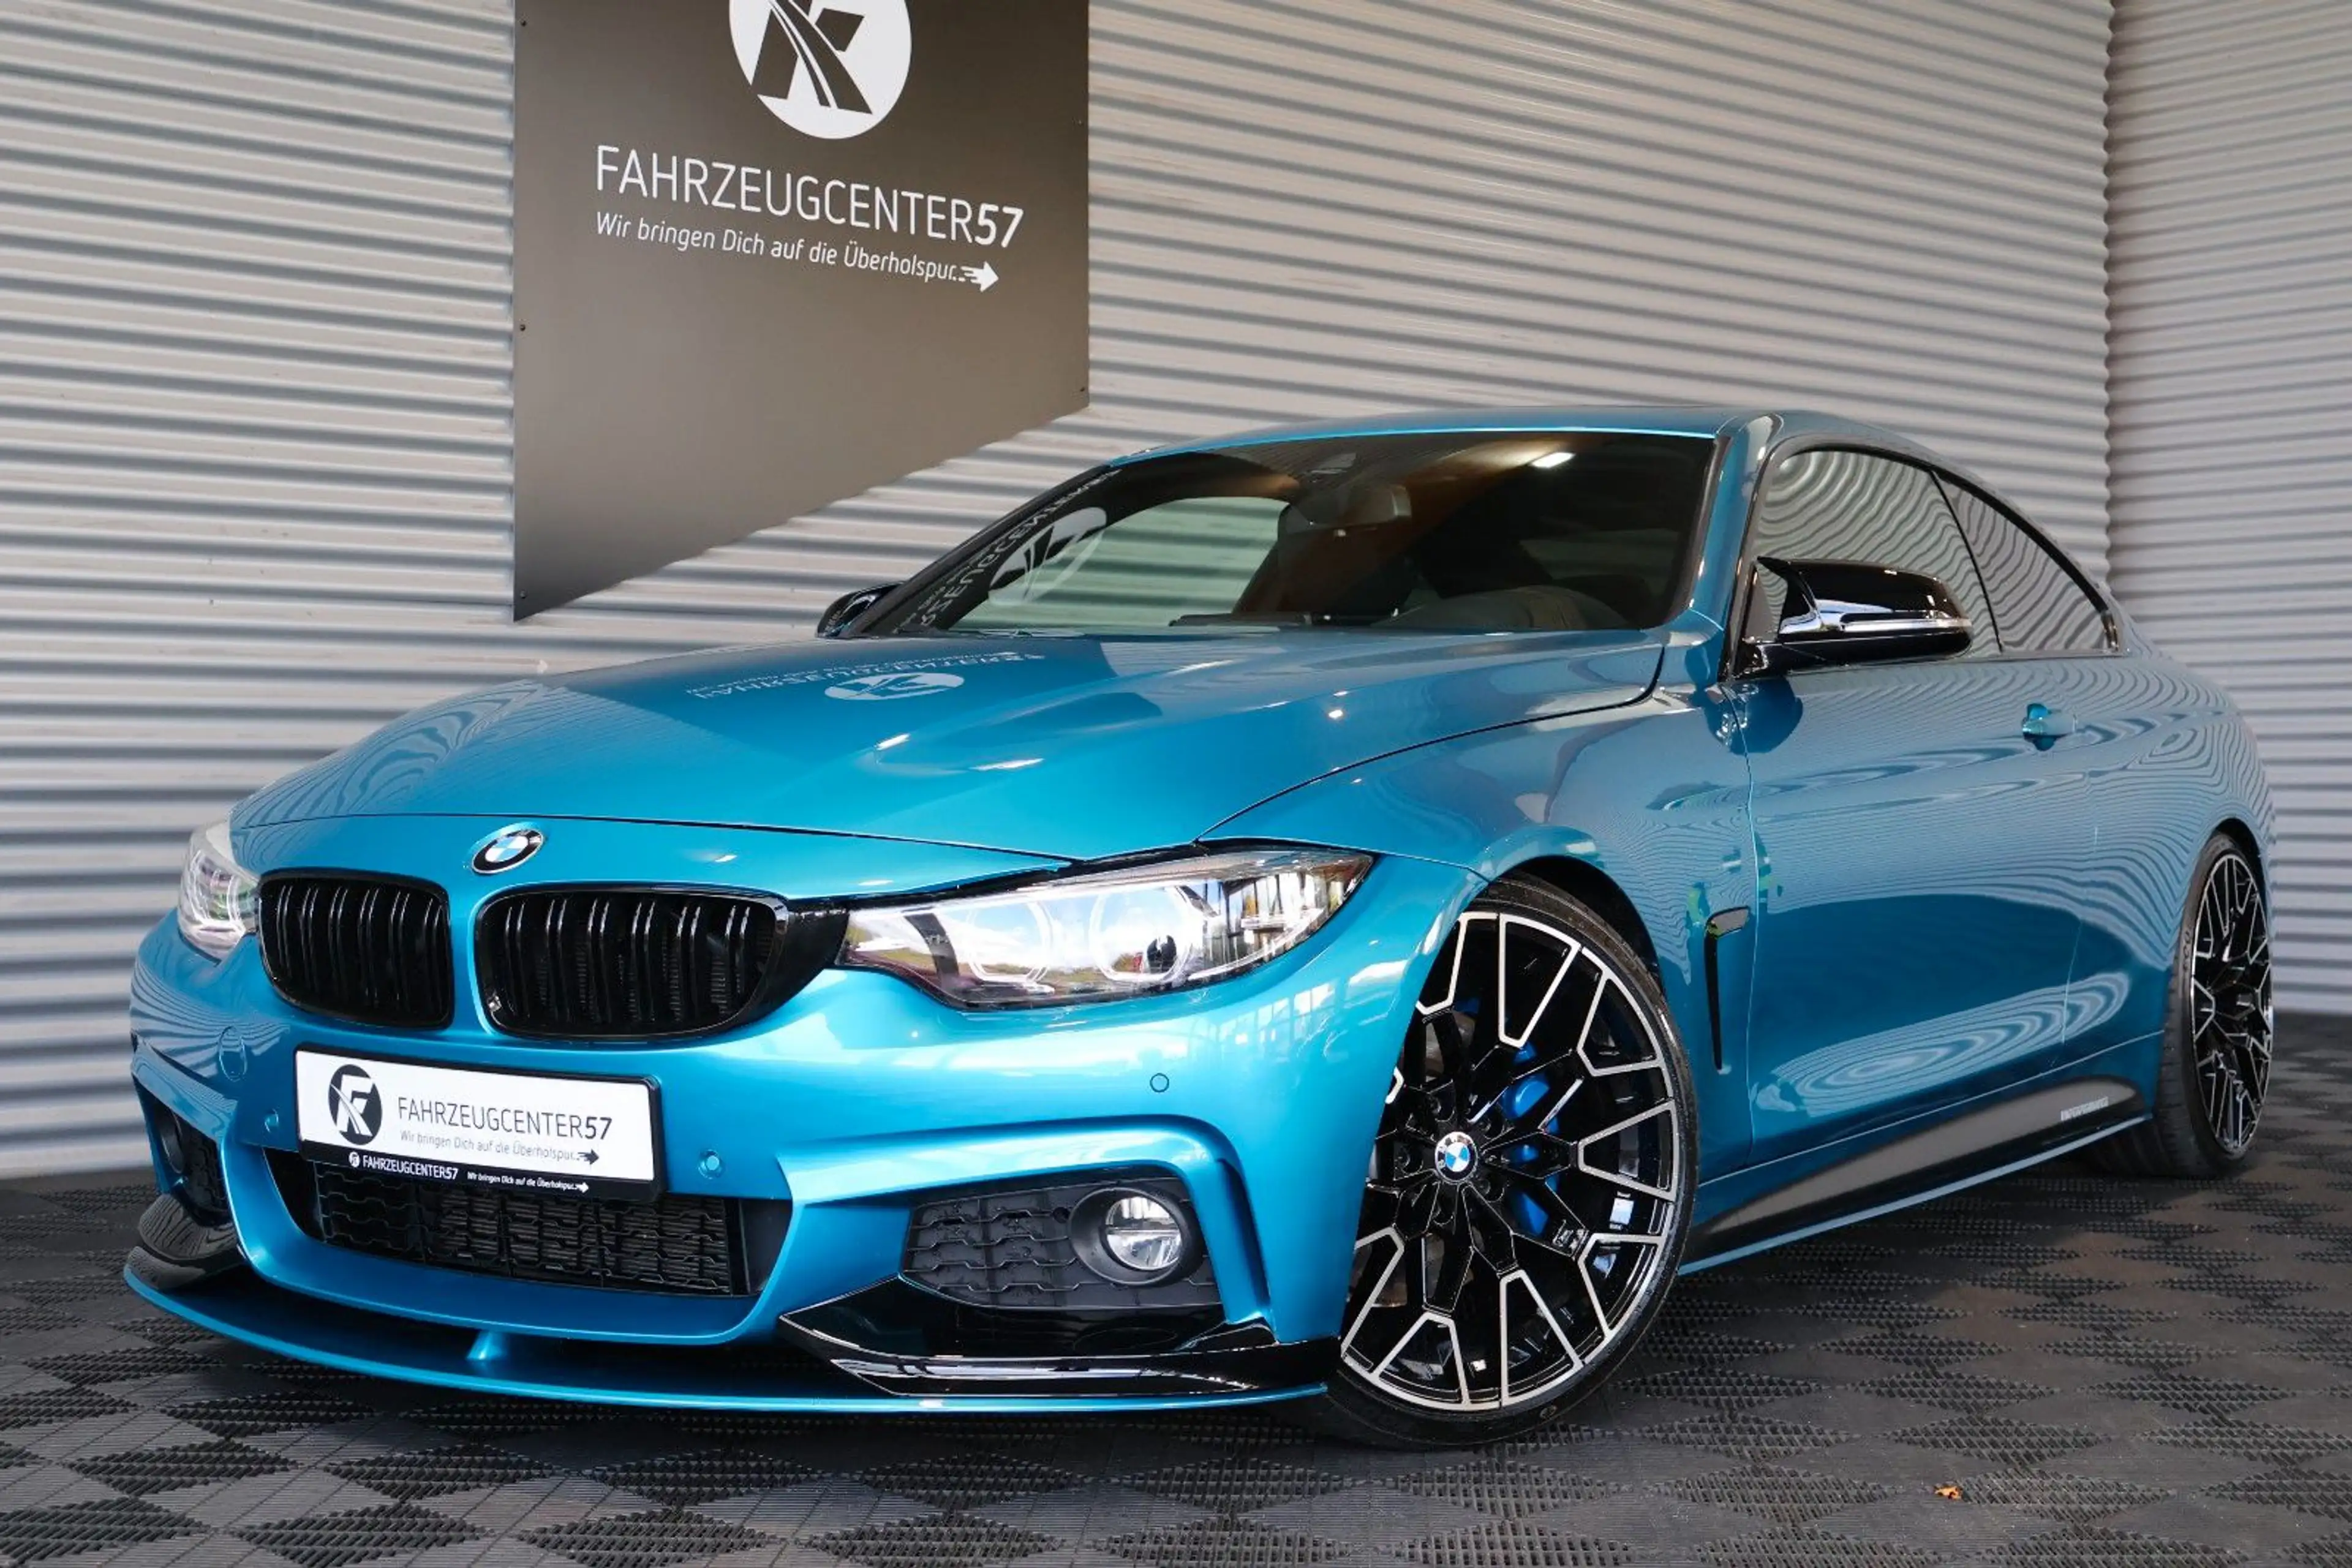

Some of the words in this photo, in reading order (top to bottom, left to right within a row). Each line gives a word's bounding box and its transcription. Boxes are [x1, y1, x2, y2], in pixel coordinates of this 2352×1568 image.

[597, 145, 1023, 248] FAHRZEUGCENTER57
[597, 211, 631, 238] Wir
[638, 217, 715, 251] bringen
[722, 229, 764, 255] Dich
[771, 238, 805, 260] auf
[809, 241, 837, 265] die
[398, 1096, 612, 1140] FAHRZEUGCENTER57
[400, 1130, 415, 1143] Wir
[417, 1133, 451, 1149] bringen
[454, 1136, 475, 1150] Dich
[477, 1139, 492, 1152] auf
[495, 1141, 510, 1155] die
[363, 1155, 459, 1180] FAHRZEUGCENTER57
[467, 1171, 478, 1180] Wir
[478, 1173, 501, 1184] bringen
